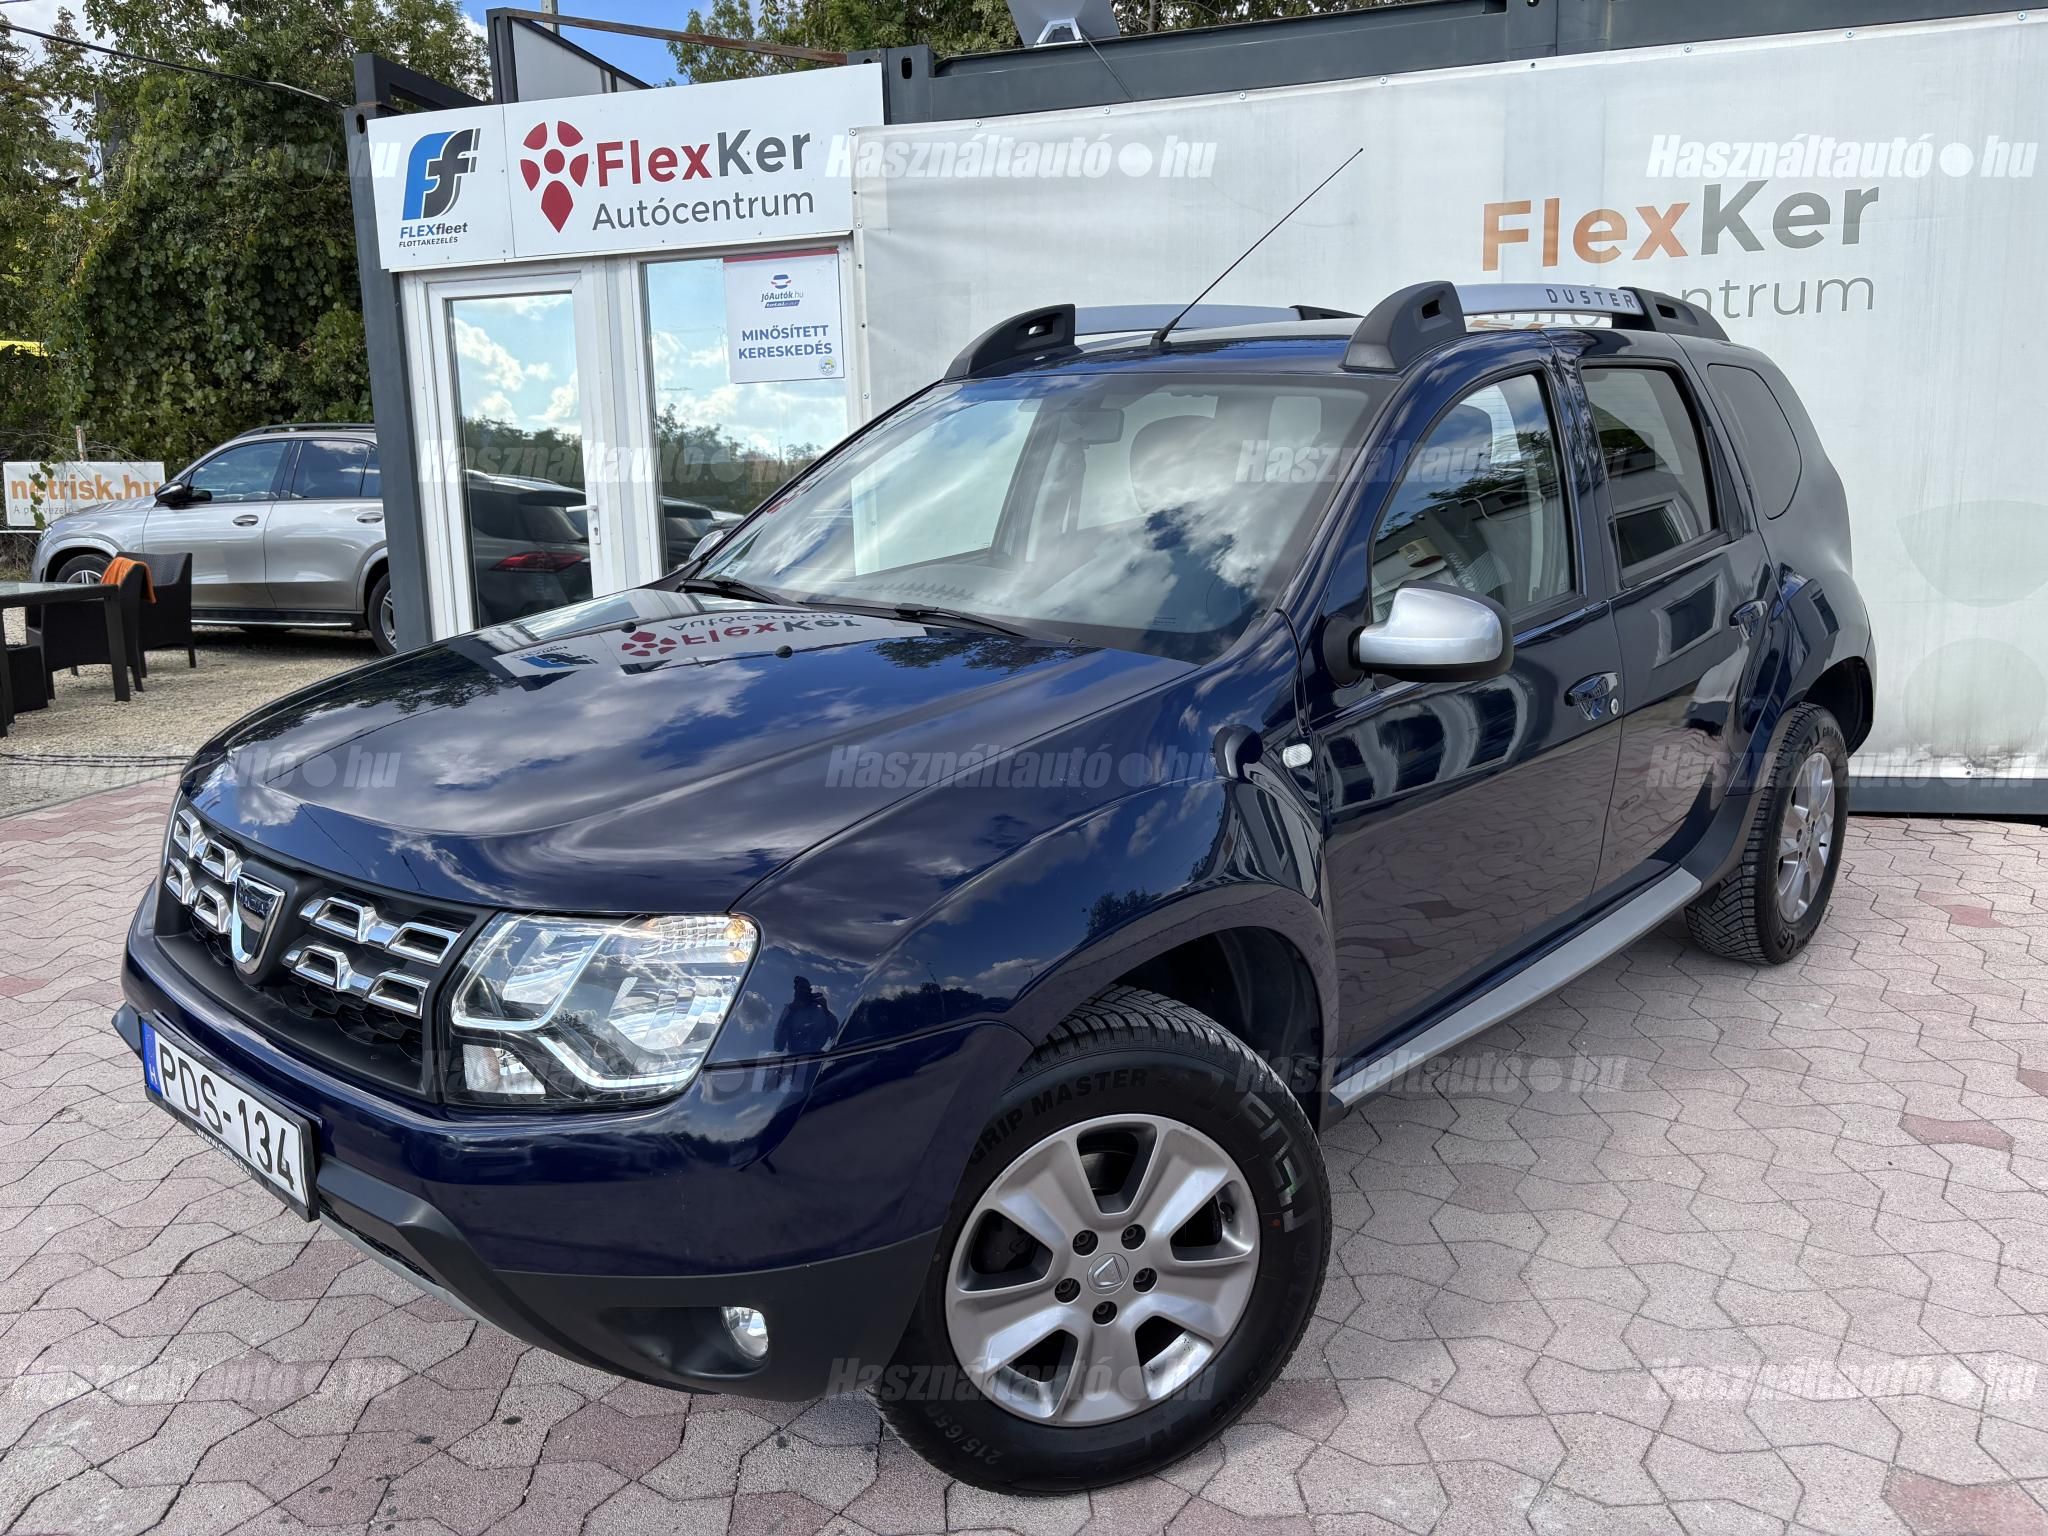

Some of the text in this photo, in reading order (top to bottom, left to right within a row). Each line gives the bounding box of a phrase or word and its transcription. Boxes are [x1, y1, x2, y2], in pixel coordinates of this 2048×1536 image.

[596, 128, 811, 187] FlexKer
[400, 222, 468, 239] FLEXfleet
[592, 191, 814, 231] Autócentrum
[1482, 180, 1880, 271] FlexKer
[398, 236, 458, 248] FLOTTAKEZELÉS
[1546, 288, 1636, 309] DUSTER
[738, 340, 833, 359] KERESKEDÉS
[1031, 1068, 1148, 1117] MASTER
[159, 1042, 295, 1192] PDS-134
